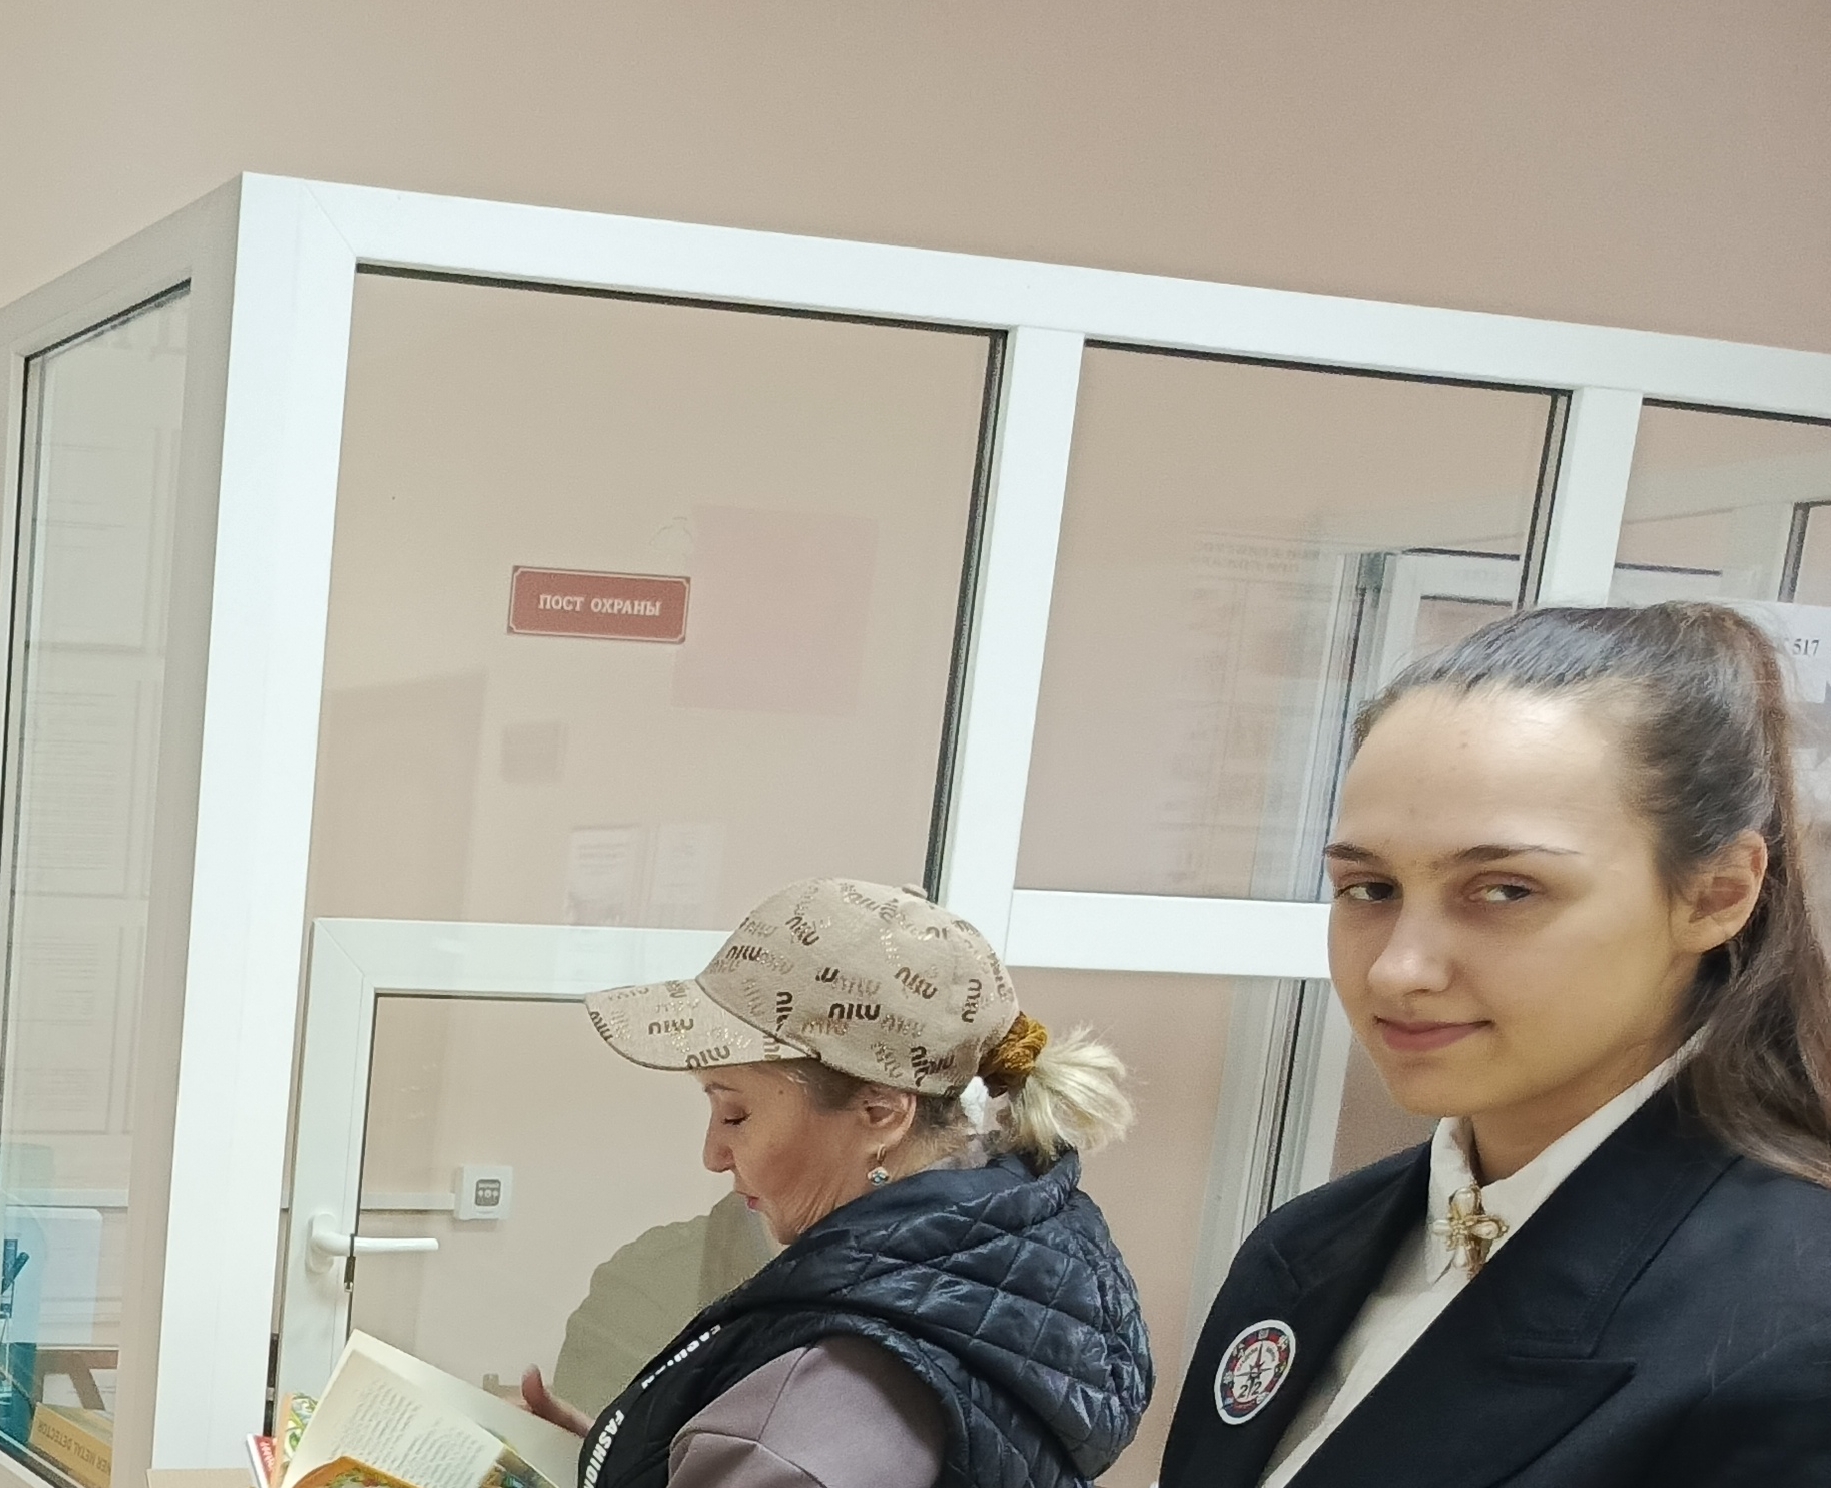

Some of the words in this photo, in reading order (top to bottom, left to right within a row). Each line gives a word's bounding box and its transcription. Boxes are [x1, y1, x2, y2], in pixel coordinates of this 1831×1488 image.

[538, 594, 585, 612] ПОСТ
[590, 597, 663, 616] ОХРАНЫ
[37, 1422, 73, 1451] DETECTOR
[73, 1441, 96, 1466] METAL
